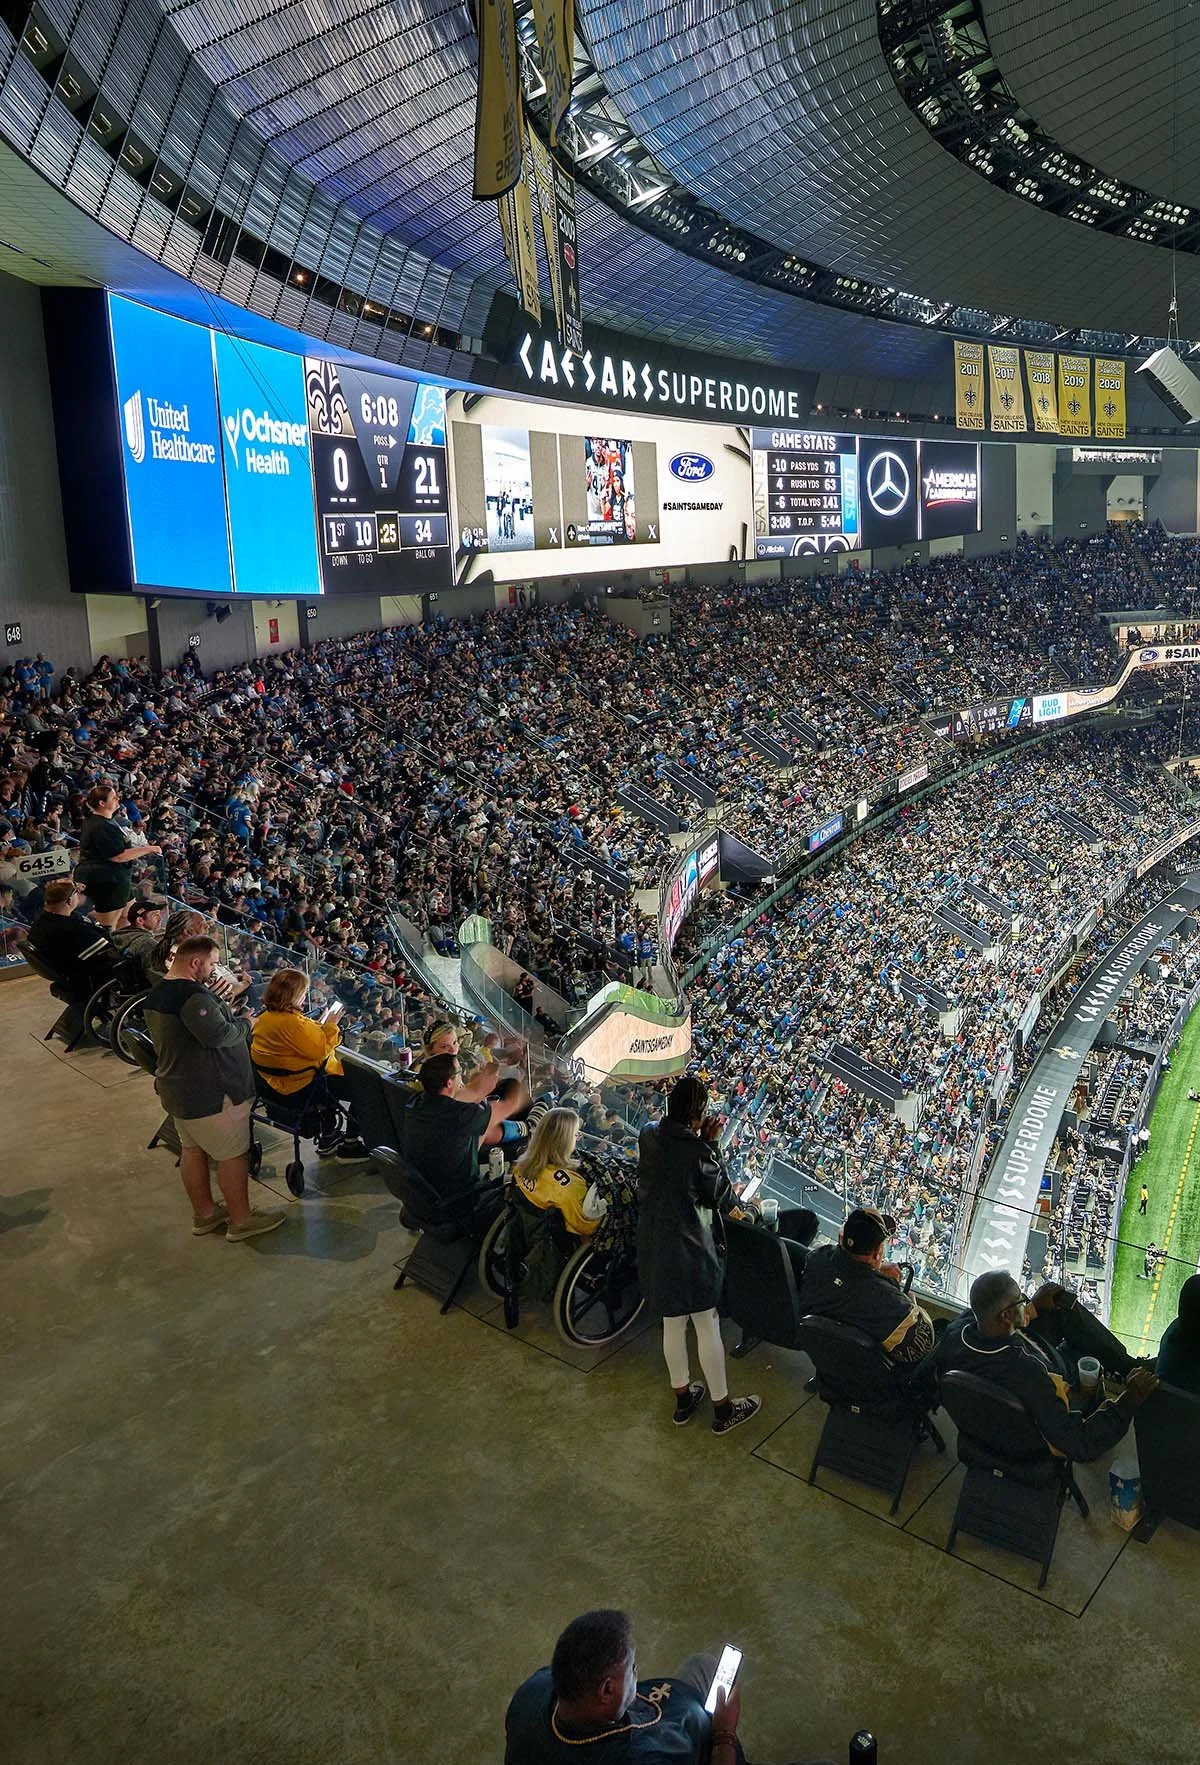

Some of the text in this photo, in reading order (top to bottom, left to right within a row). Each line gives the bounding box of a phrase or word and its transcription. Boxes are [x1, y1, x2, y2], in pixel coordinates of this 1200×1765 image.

[519, 332, 800, 419] CAESARS SUPERDOME
[961, 363, 979, 376] 2011
[995, 367, 1015, 380] 2017
[1032, 371, 1051, 384] 2018
[1064, 375, 1085, 387] 2019
[1099, 378, 1121, 390] 2020
[147, 397, 190, 432] United
[361, 392, 399, 427] 6:08
[242, 408, 309, 447] Ochsner
[958, 417, 983, 428] SAINTS
[994, 420, 1025, 430] SAINTS
[1060, 425, 1089, 435] SAINTS
[1096, 427, 1124, 437] SAINTS
[151, 430, 216, 464] Healthcare
[772, 433, 836, 451] GAME STATS
[246, 448, 290, 475] Health
[377, 454, 388, 466] QTR
[333, 448, 349, 491] 0
[677, 457, 706, 477] Ford
[790, 461, 806, 471] PASS
[806, 461, 819, 471] YDS
[824, 461, 836, 474] 78
[379, 468, 388, 489] 1
[414, 456, 440, 495] 21
[776, 478, 836, 491] 4 RUSH YDS 63
[662, 502, 723, 511] #SAINTSGAMEDAY
[790, 497, 807, 507] TOTAL
[807, 497, 821, 507] YDS
[823, 495, 838, 508] 141
[771, 516, 791, 529] 3:08
[821, 515, 841, 528] 5:44
[356, 520, 372, 546] 10
[415, 519, 433, 543] 34
[332, 555, 348, 566] DOWN
[429, 592, 439, 600] 651
[306, 608, 317, 618] 650
[7, 626, 21, 642] 648
[189, 635, 200, 647] 649
[1042, 699, 1059, 708] BUD
[1022, 705, 1032, 717] 21
[1039, 706, 1062, 717] LIGHT
[19, 856, 55, 872] 645
[1115, 921, 1163, 972] SUPERDOME
[1003, 1084, 1058, 1187] SUPERDOME
[553, 1169, 571, 1186] 9
